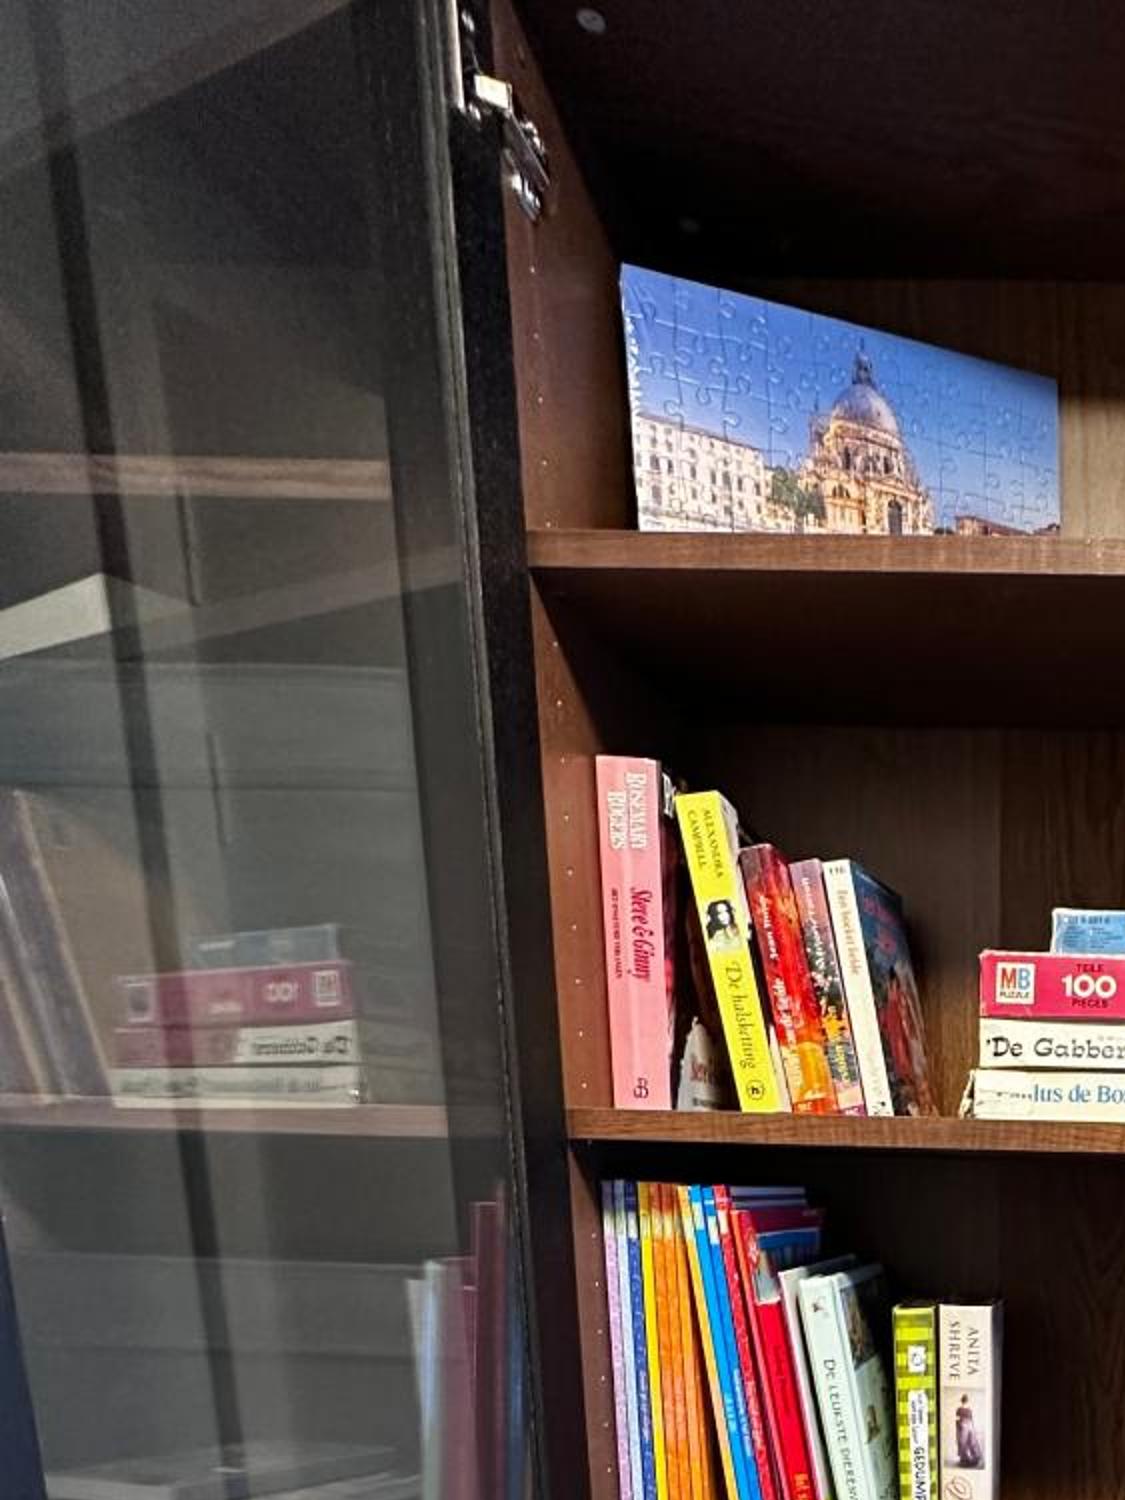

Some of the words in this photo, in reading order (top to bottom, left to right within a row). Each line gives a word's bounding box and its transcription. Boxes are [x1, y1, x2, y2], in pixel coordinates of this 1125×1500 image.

[607, 790, 627, 850] ROGERS
[703, 809, 725, 879] ALEXANDRA
[723, 961, 743, 991] De
[1000, 967, 1031, 990] MB
[1061, 975, 1117, 999] 100
[729, 996, 758, 1070] halsketting
[1068, 1084, 1091, 1104] de
[948, 1320, 962, 1382] SHREVE
[966, 1326, 981, 1376] ANITA
